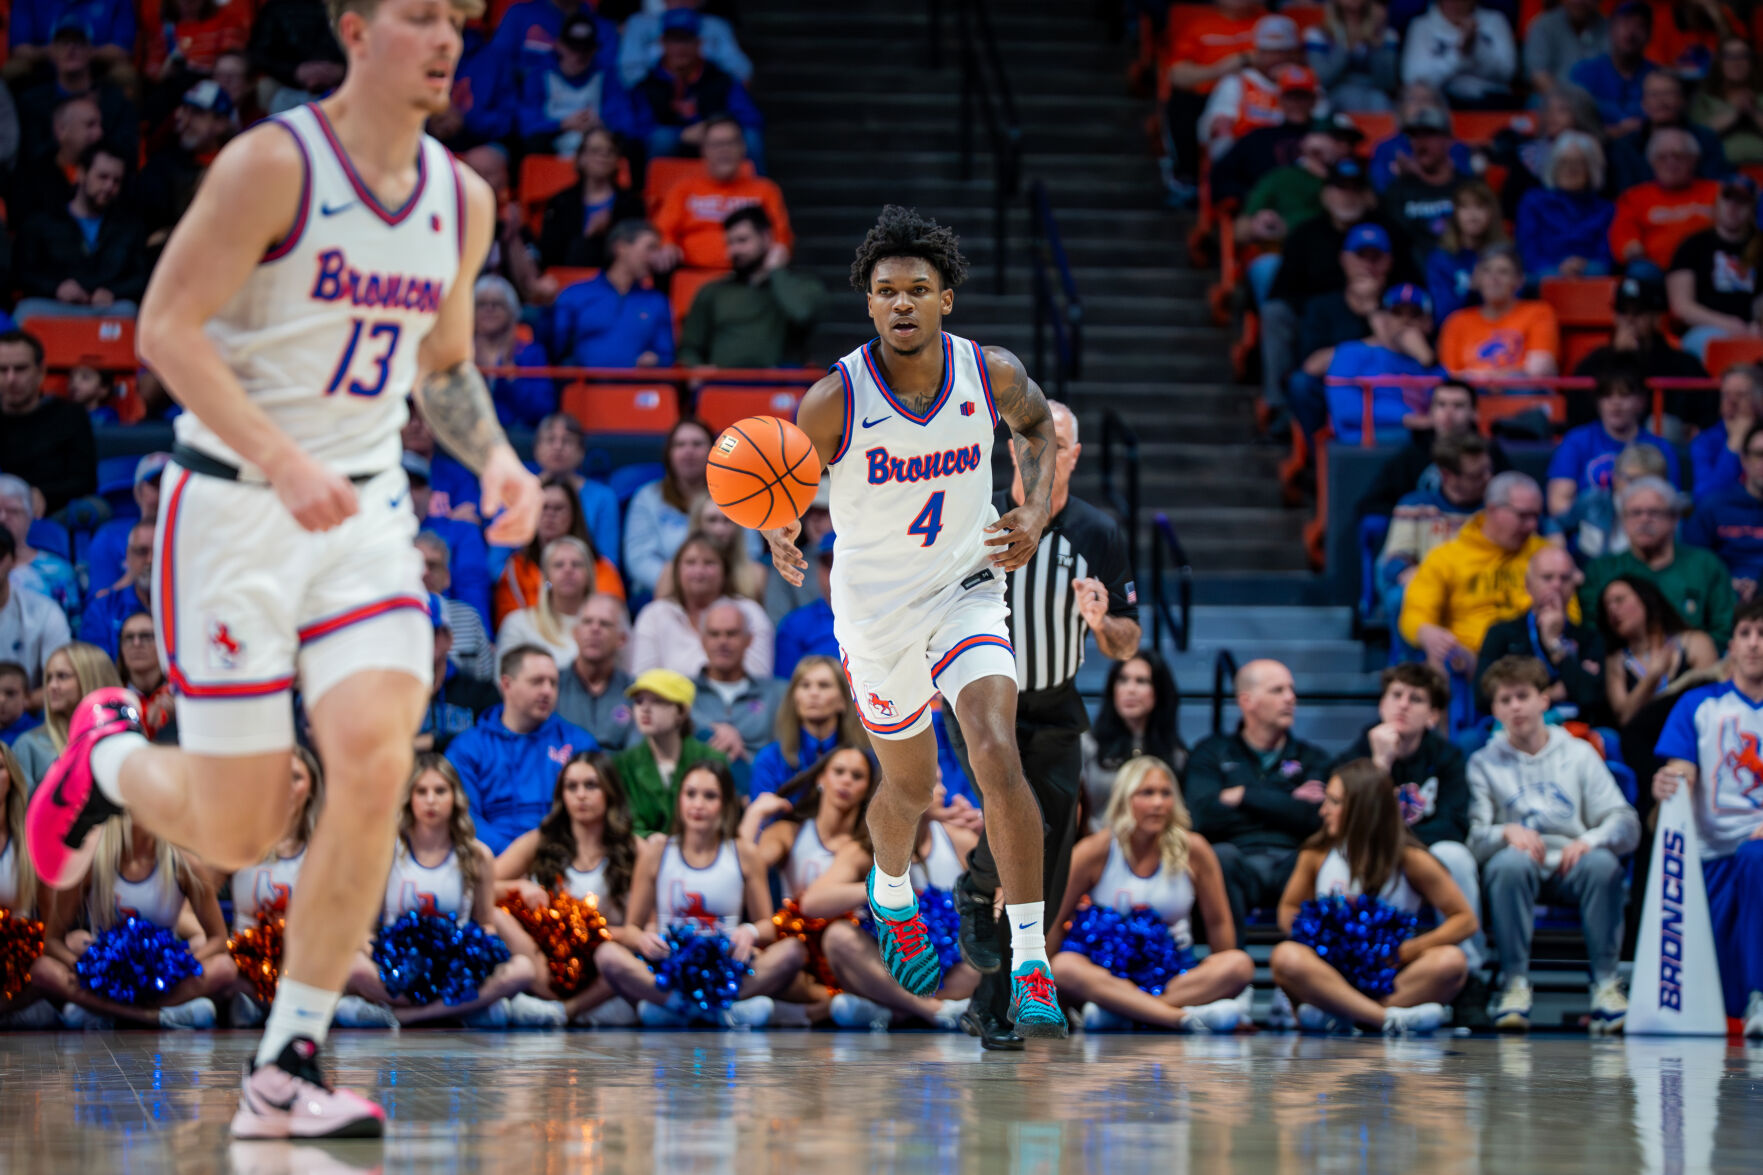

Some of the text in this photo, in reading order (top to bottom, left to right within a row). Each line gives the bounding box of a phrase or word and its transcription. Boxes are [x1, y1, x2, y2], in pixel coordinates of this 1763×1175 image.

[324, 317, 402, 396] 13
[865, 442, 981, 485] Broncos
[907, 489, 945, 547] 4
[1659, 828, 1685, 1014] BRONCOS
